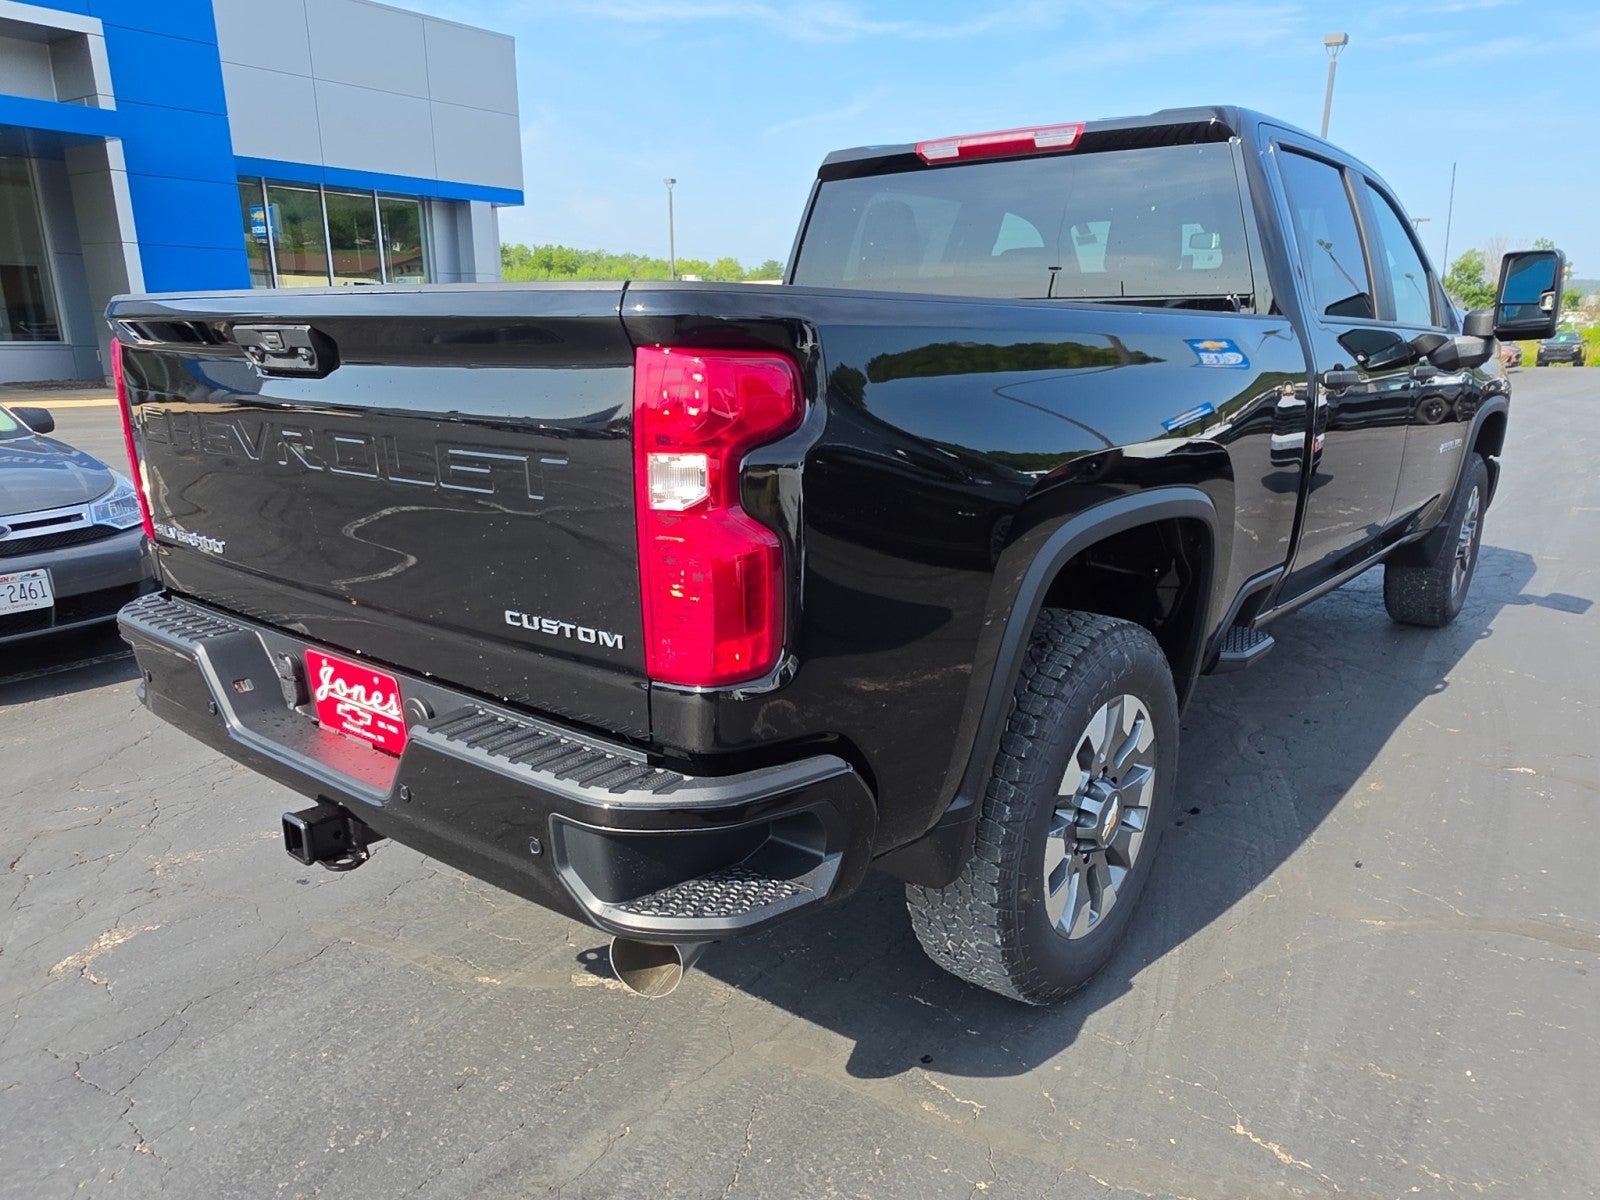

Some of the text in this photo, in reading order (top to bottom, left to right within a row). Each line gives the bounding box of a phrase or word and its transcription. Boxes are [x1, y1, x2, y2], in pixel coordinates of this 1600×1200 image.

[140, 406, 568, 500] CHEVROLET
[504, 610, 624, 650] CUSTOM
[316, 664, 401, 716] Jones
